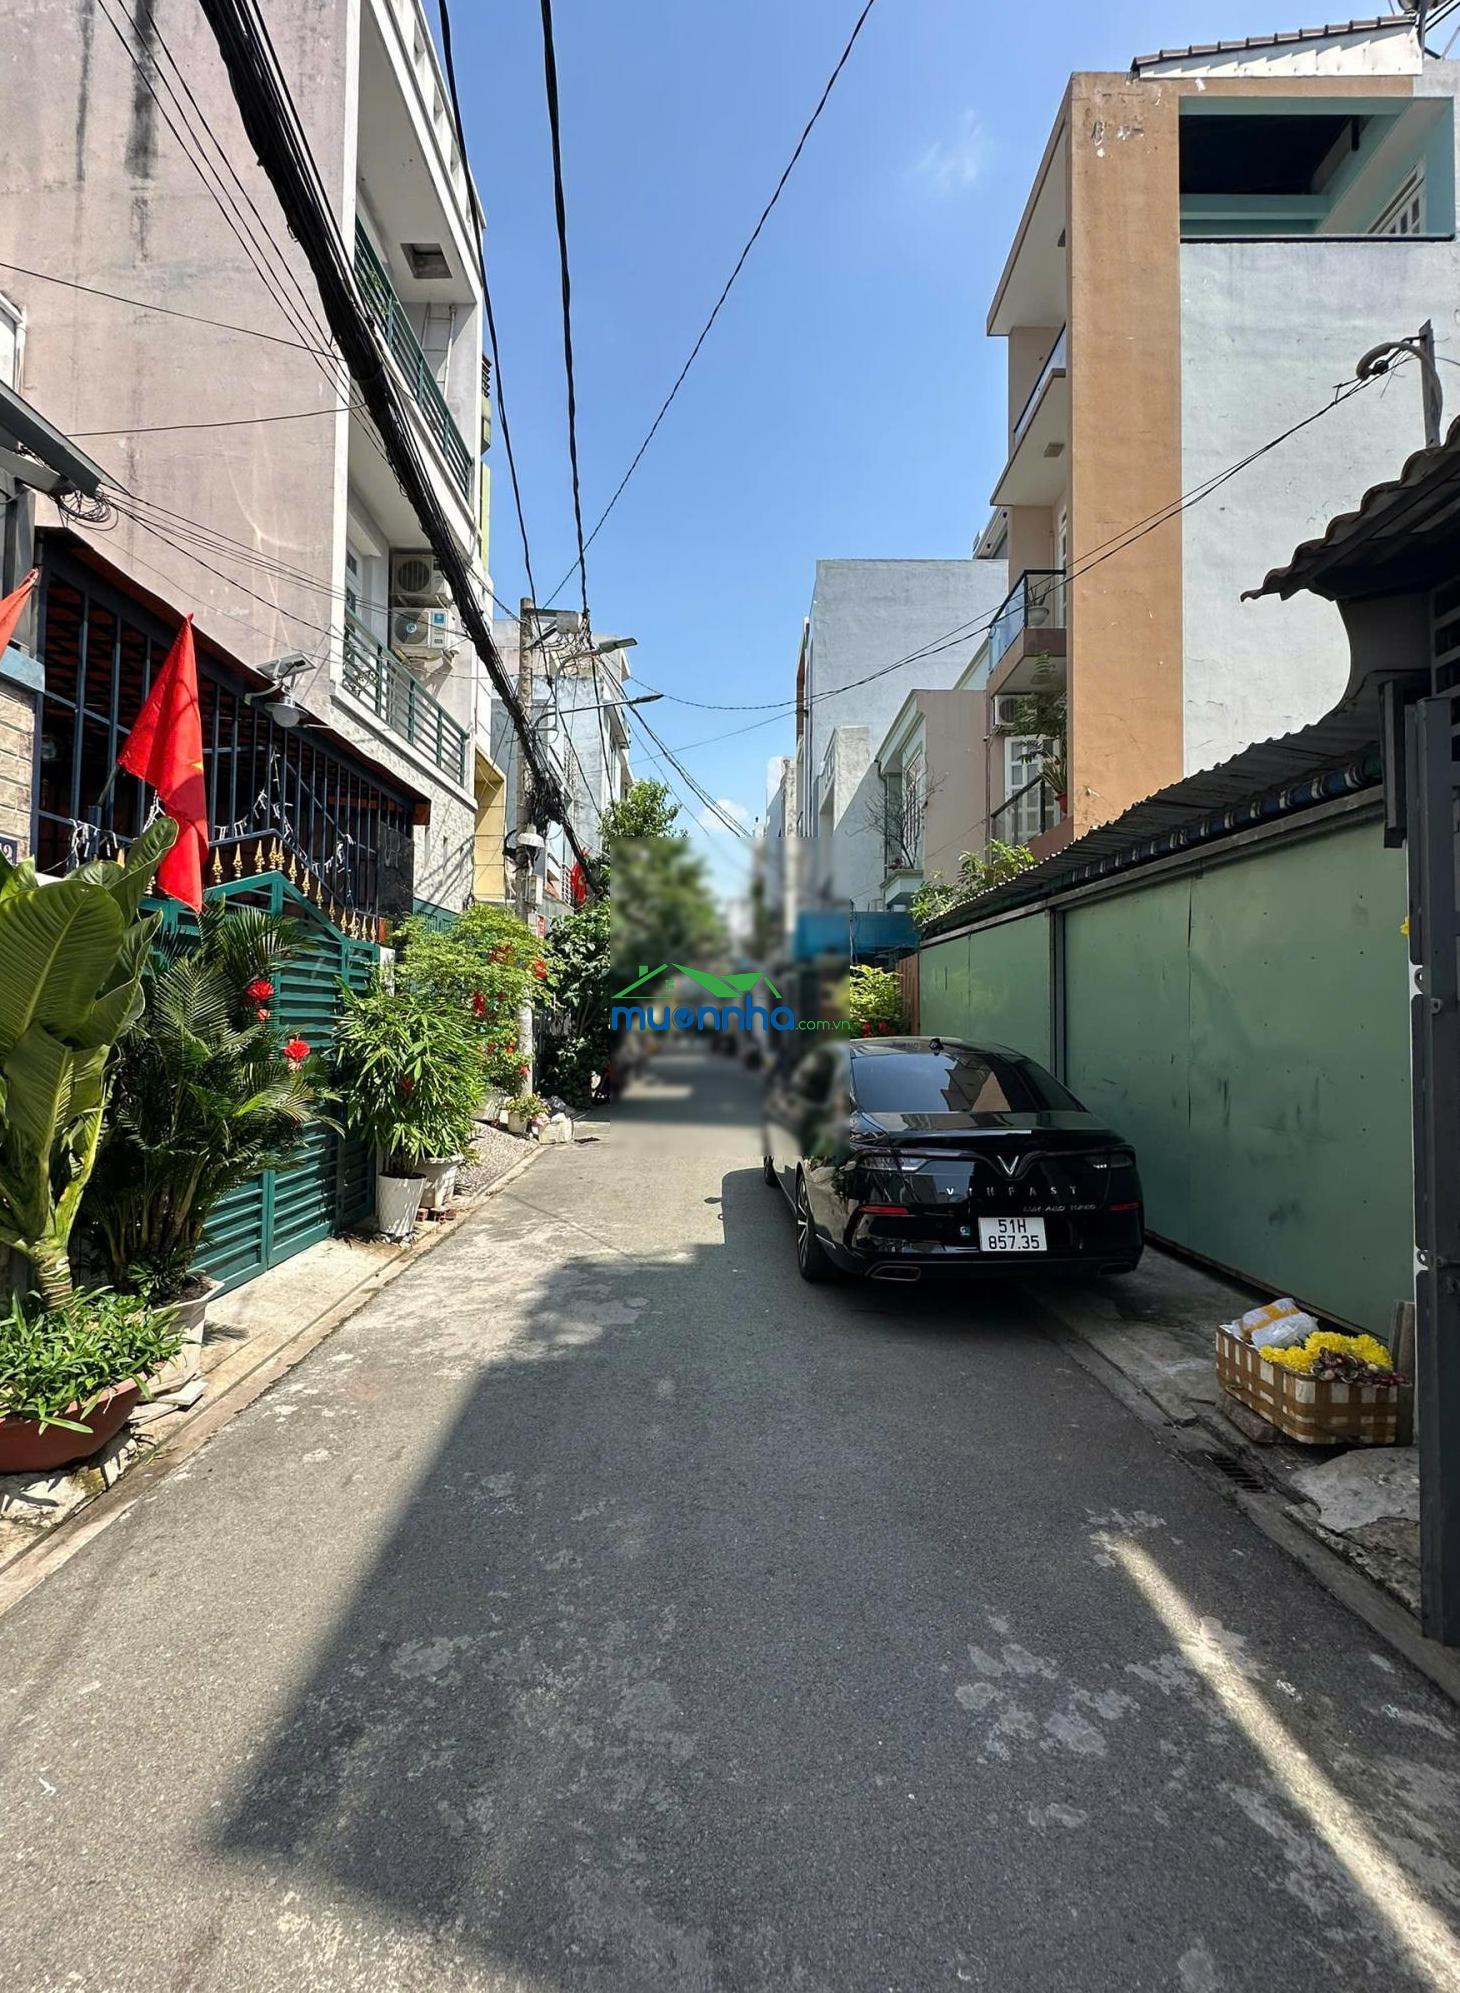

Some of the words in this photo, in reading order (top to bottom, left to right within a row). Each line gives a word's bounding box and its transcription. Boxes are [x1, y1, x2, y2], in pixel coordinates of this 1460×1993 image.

[946, 1186, 1077, 1197] VINFAST
[998, 1219, 1027, 1233] 51H
[988, 1235, 1040, 1250] 857.35
